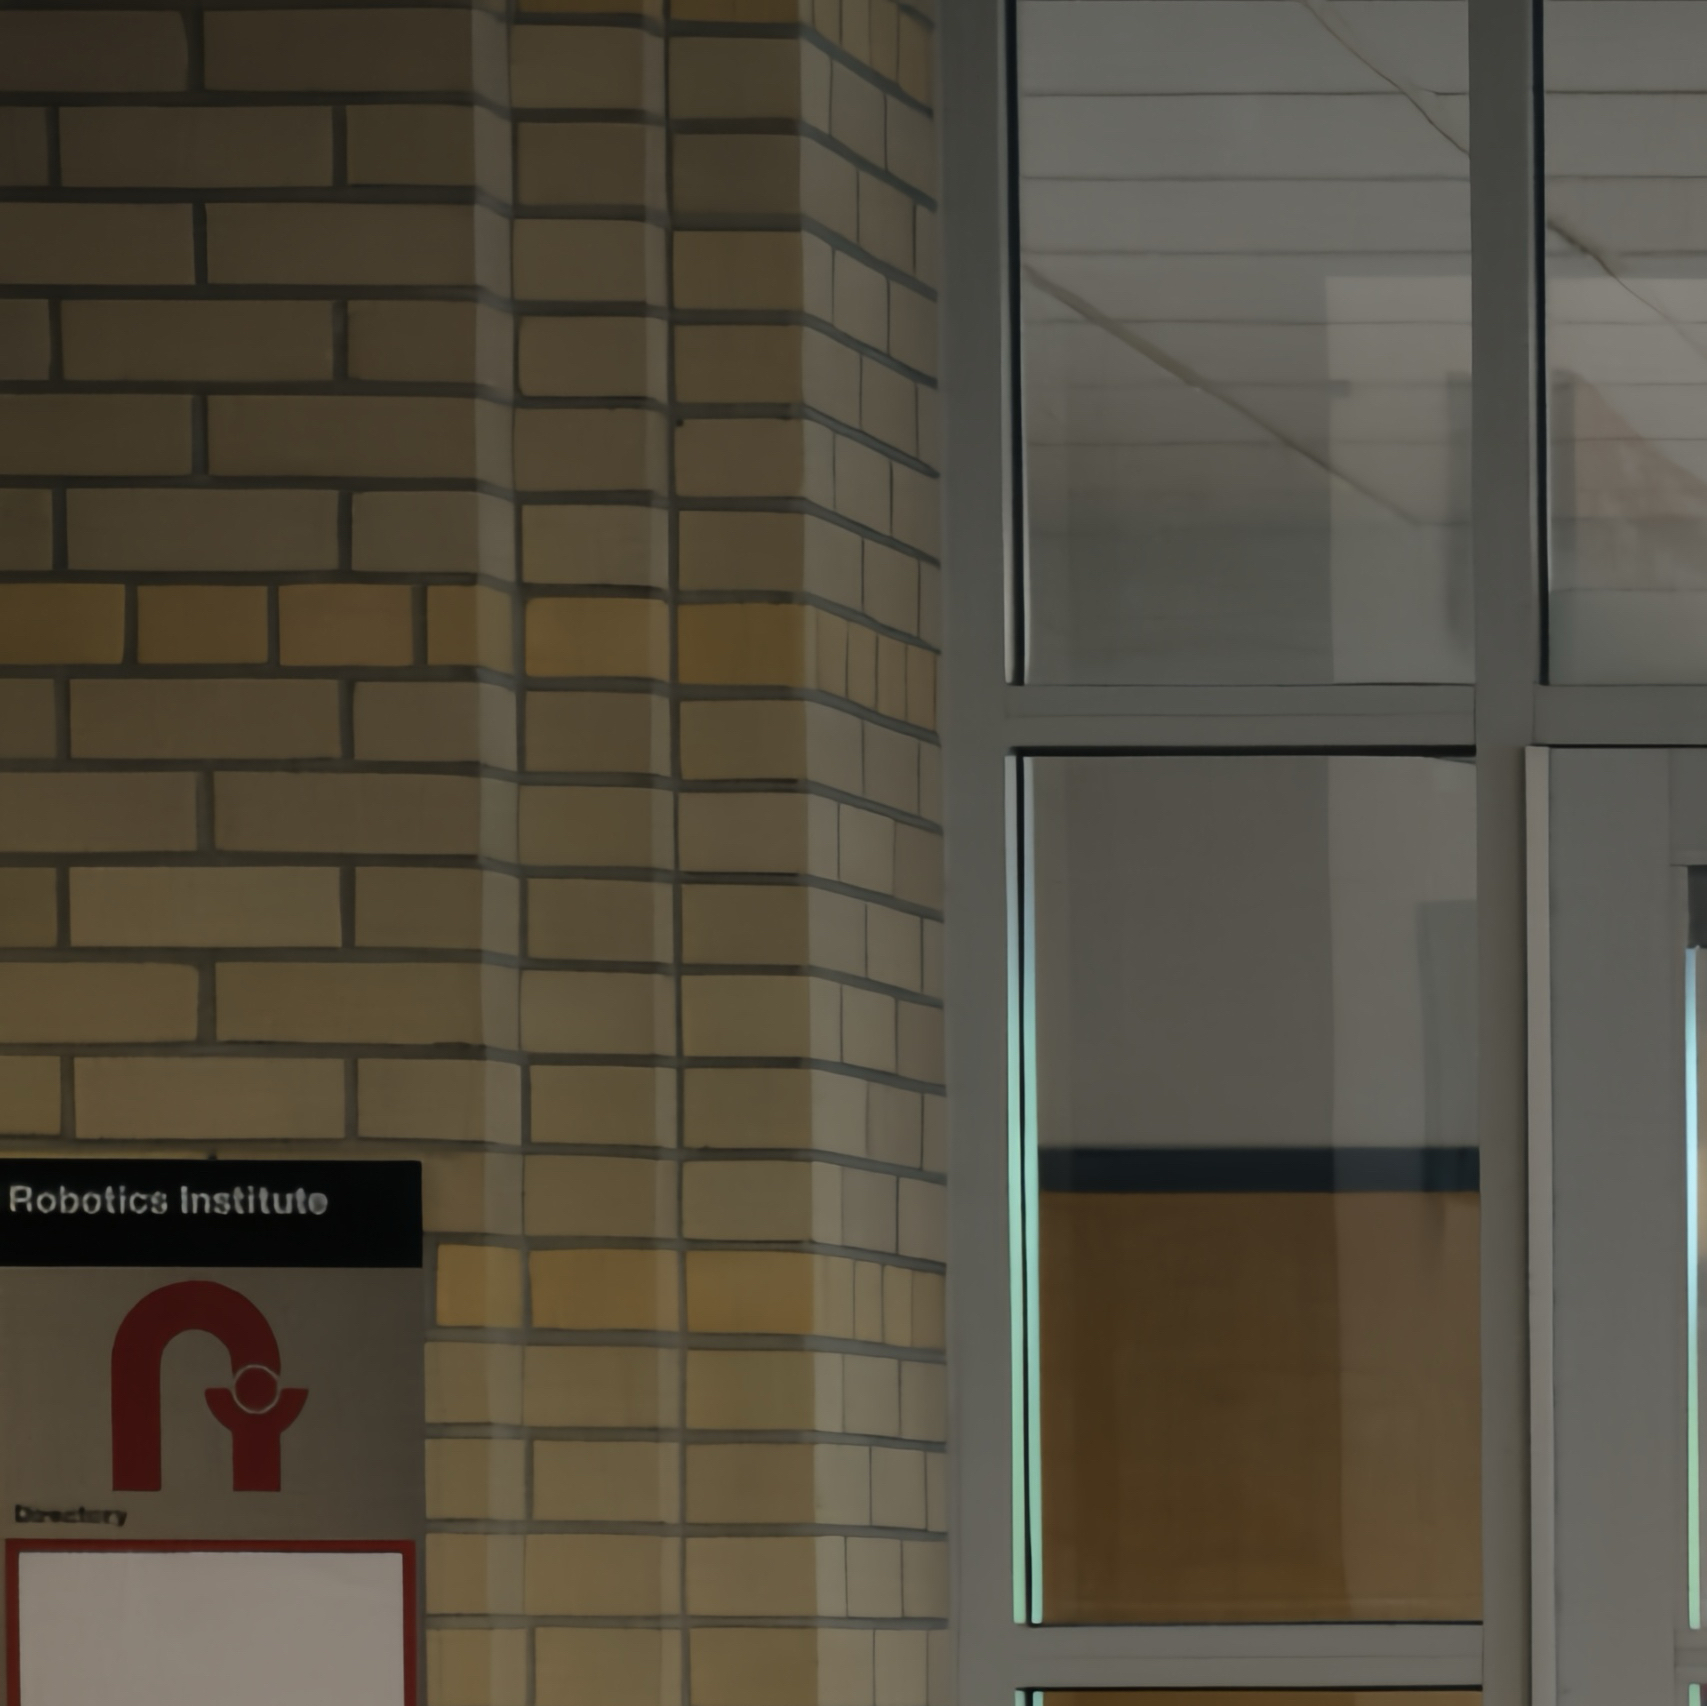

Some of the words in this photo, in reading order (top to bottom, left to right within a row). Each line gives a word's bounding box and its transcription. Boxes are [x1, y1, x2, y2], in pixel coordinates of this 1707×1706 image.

[9, 1185, 168, 1215] Robotics
[180, 1185, 329, 1216] Institute
[14, 1504, 128, 1528] Directory
